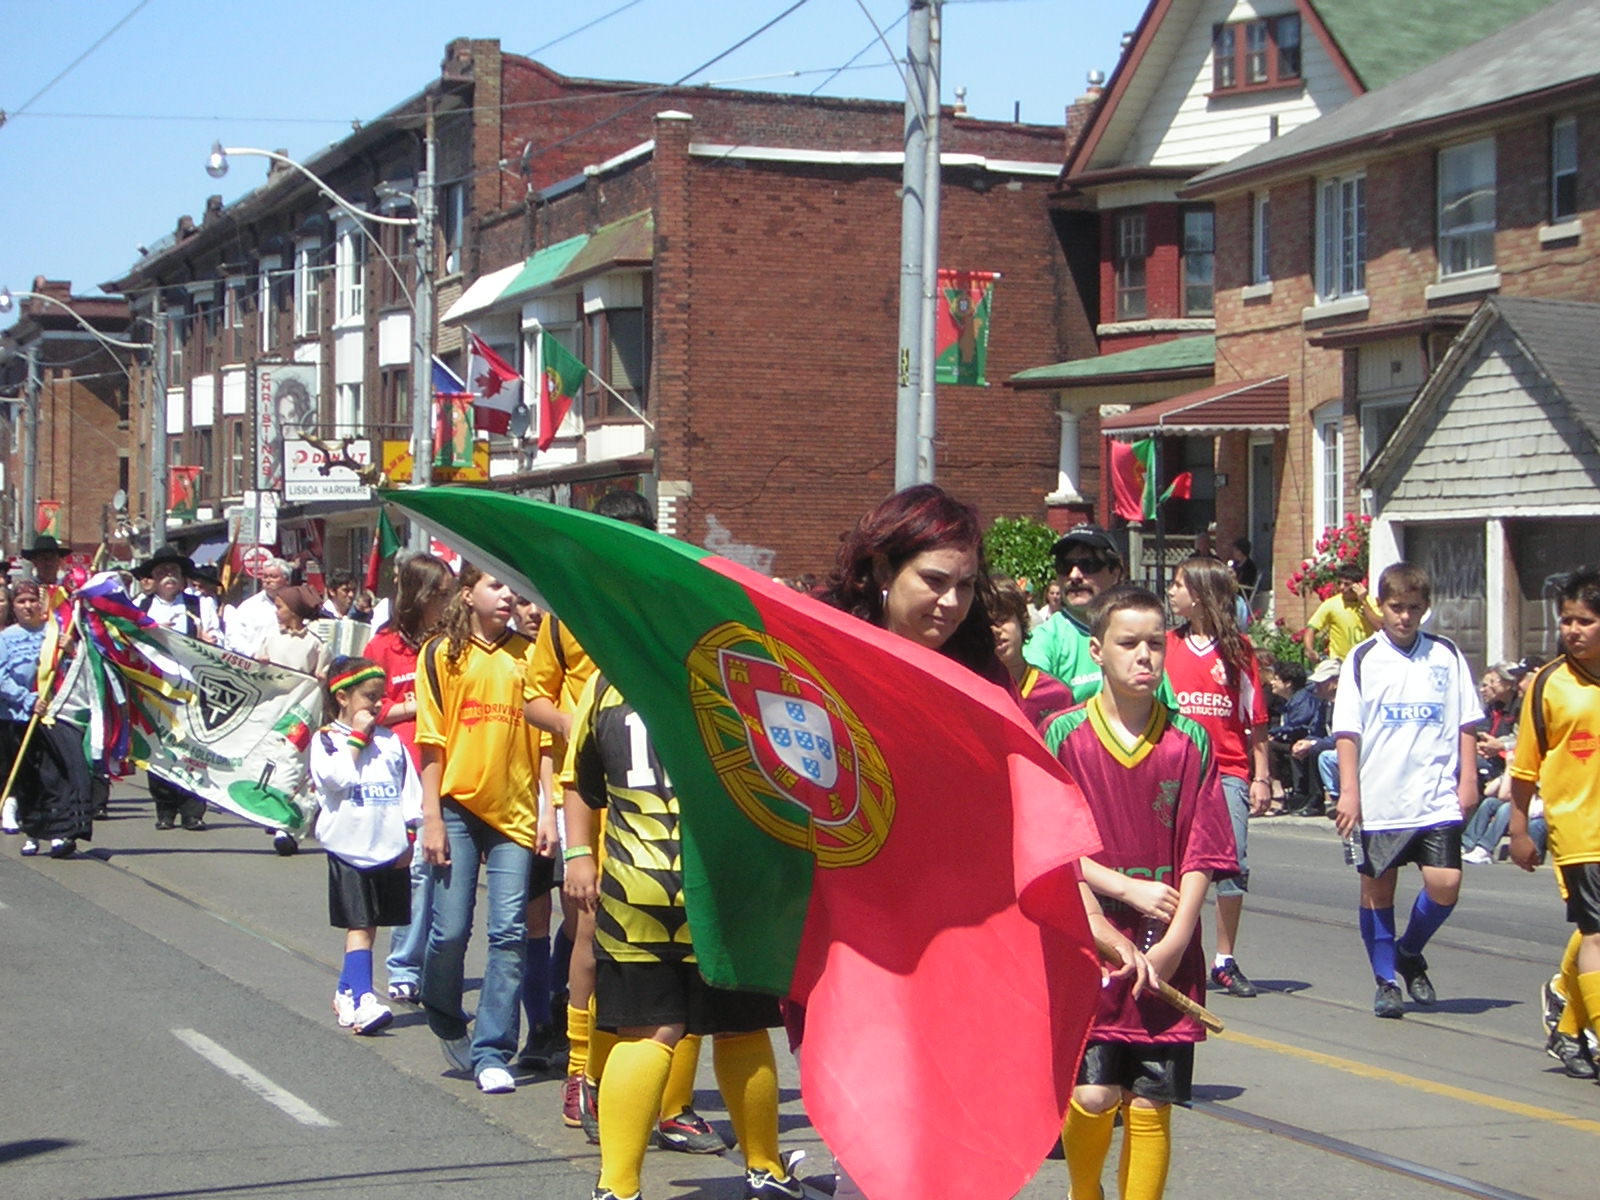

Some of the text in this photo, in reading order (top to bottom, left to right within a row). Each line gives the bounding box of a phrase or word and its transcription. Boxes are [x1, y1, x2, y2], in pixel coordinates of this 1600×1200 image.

[261, 372, 272, 476] CHRISTINAS
[289, 485, 367, 495] LISBOA HARDWARE
[221, 652, 252, 670] VISEU
[1174, 691, 1233, 708] OGERS
[484, 703, 524, 719] DRIVING
[1389, 706, 1432, 720] TRIO
[361, 784, 398, 799] TRIO
